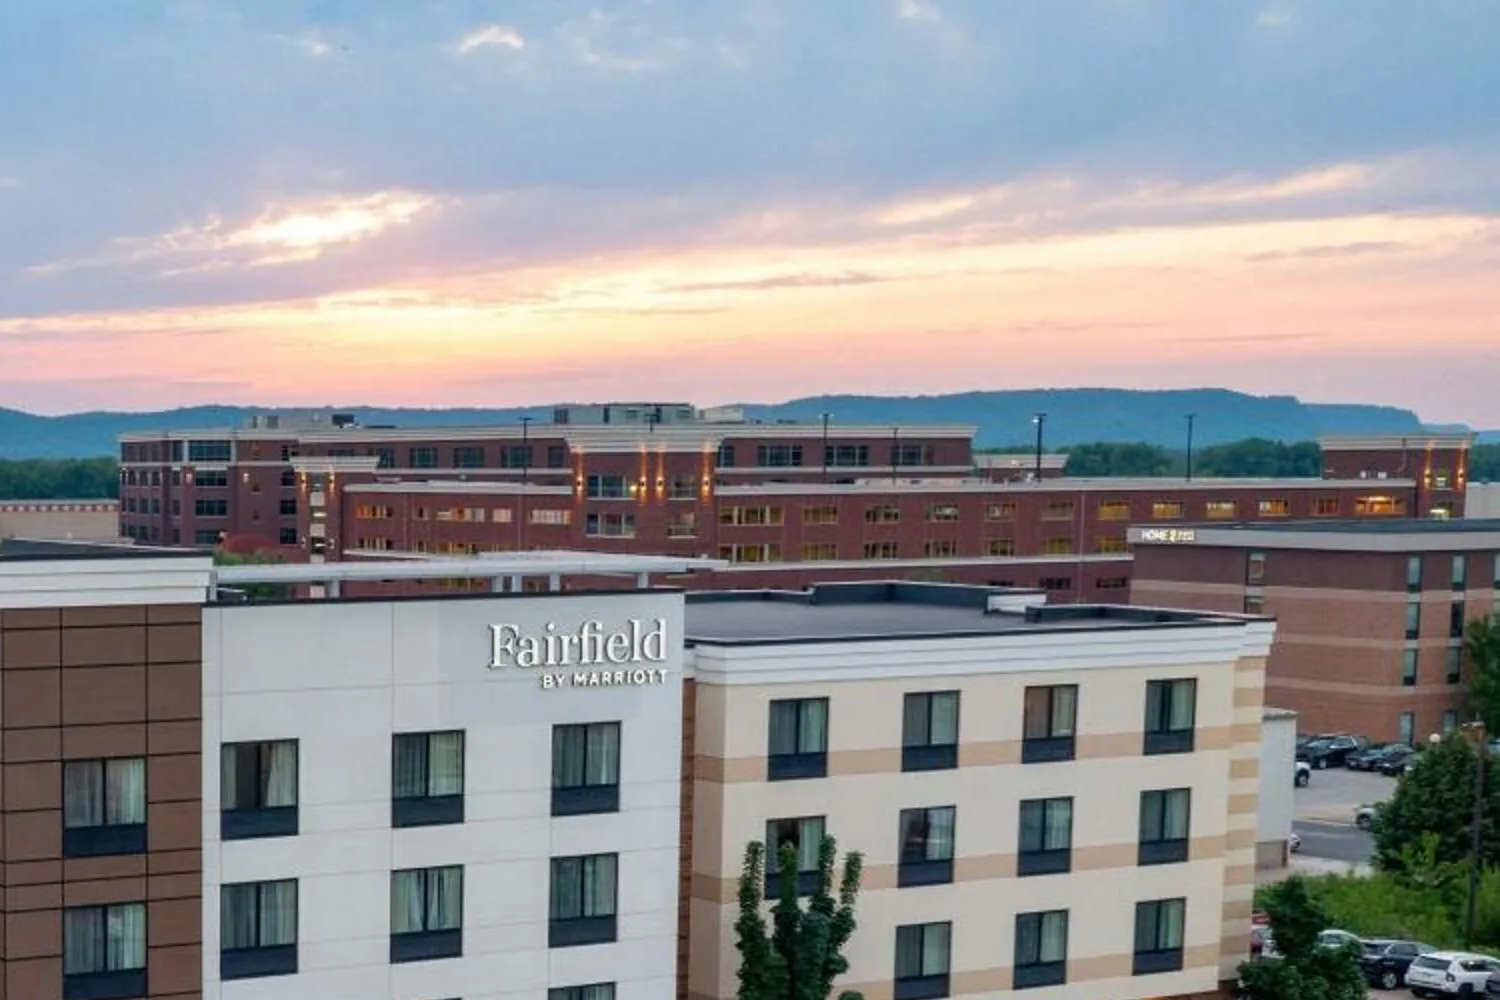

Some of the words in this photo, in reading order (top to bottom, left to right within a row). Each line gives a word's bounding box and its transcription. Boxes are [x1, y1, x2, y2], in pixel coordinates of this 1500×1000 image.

[489, 617, 667, 668] Fairfield
[542, 674, 565, 689] BY
[572, 669, 668, 687] MARRIOTT
